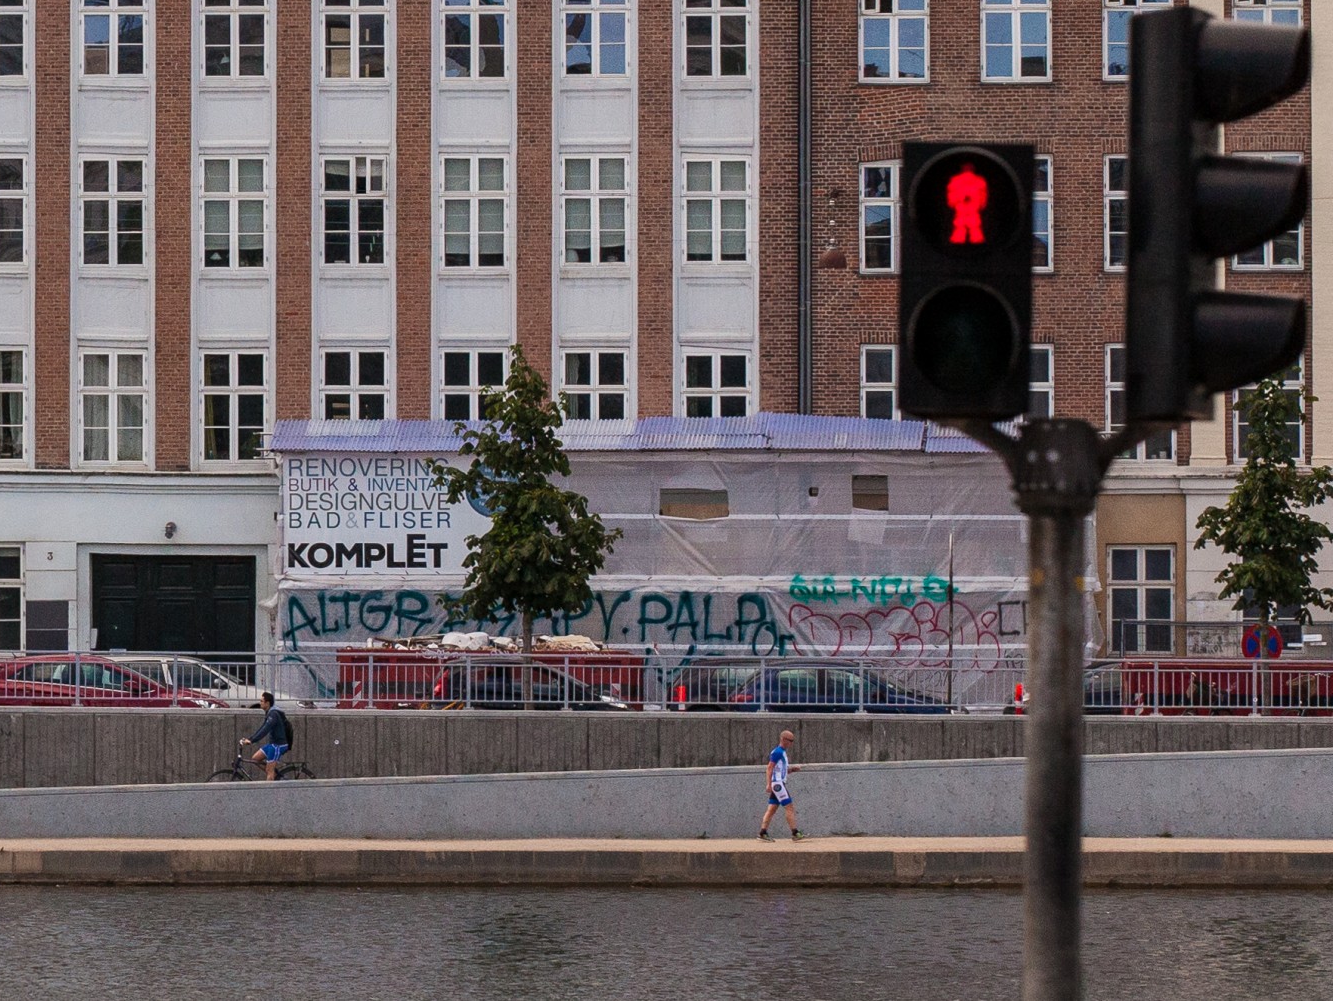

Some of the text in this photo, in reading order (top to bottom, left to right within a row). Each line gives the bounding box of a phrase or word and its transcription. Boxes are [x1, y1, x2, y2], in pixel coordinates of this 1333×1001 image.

[288, 478, 338, 491] BUTIK
[347, 478, 358, 491] &
[289, 492, 450, 511] DESIGNGULVE
[289, 511, 341, 529] BAD
[364, 511, 451, 529] FLISER
[47, 551, 54, 561] 3
[287, 533, 448, 569] KOMPLET
